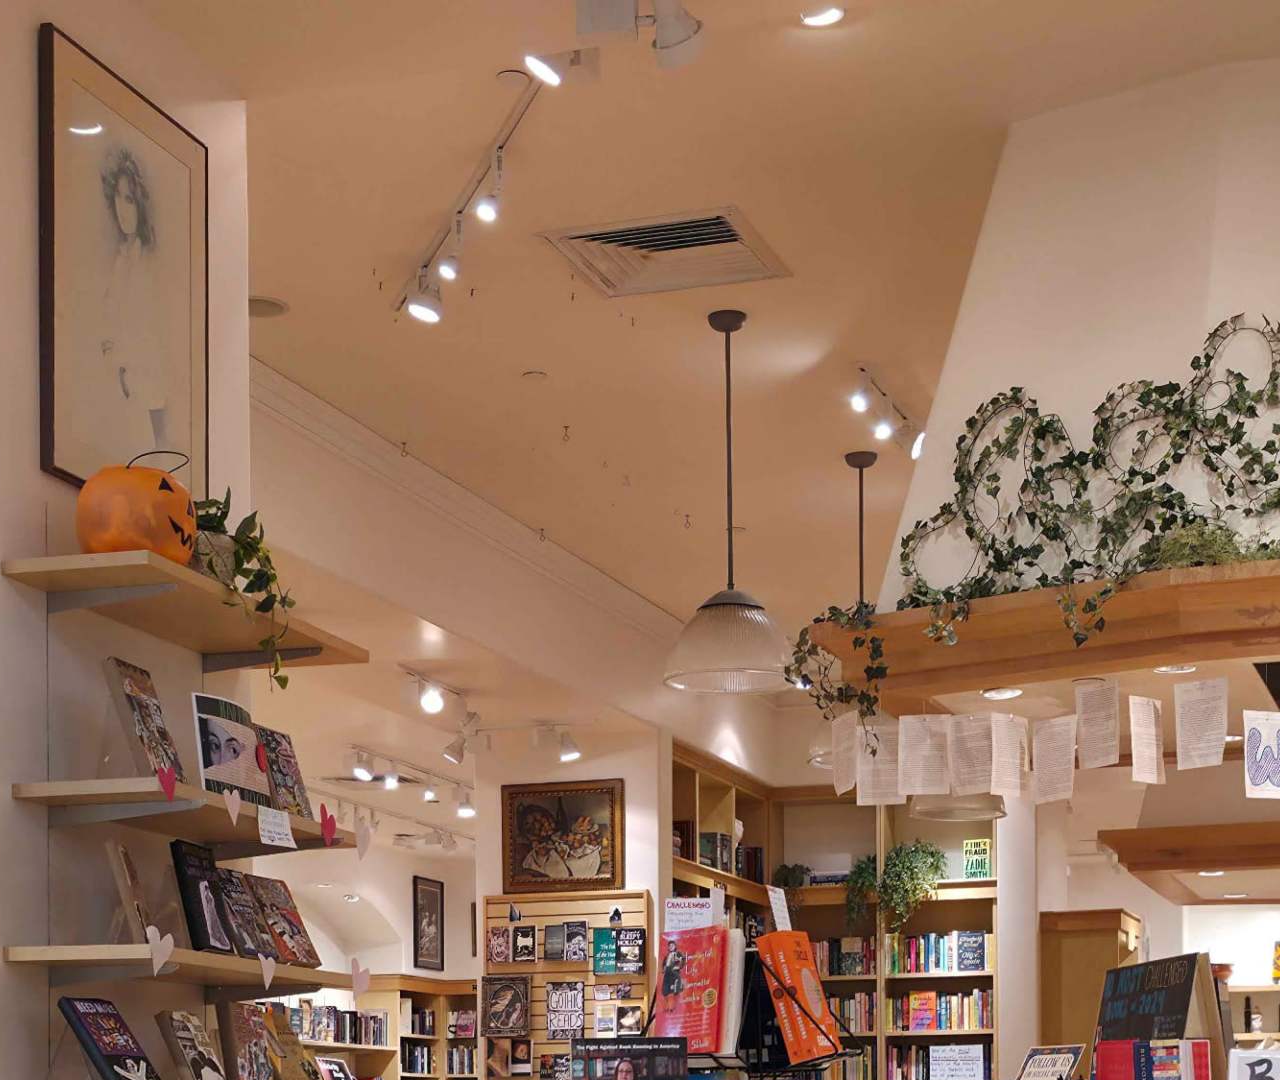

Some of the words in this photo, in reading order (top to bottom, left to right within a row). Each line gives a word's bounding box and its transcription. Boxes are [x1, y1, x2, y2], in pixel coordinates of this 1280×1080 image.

[966, 858, 988, 870] ZADIE
[549, 991, 582, 1010] GOTHIC
[549, 1012, 583, 1030] READS
